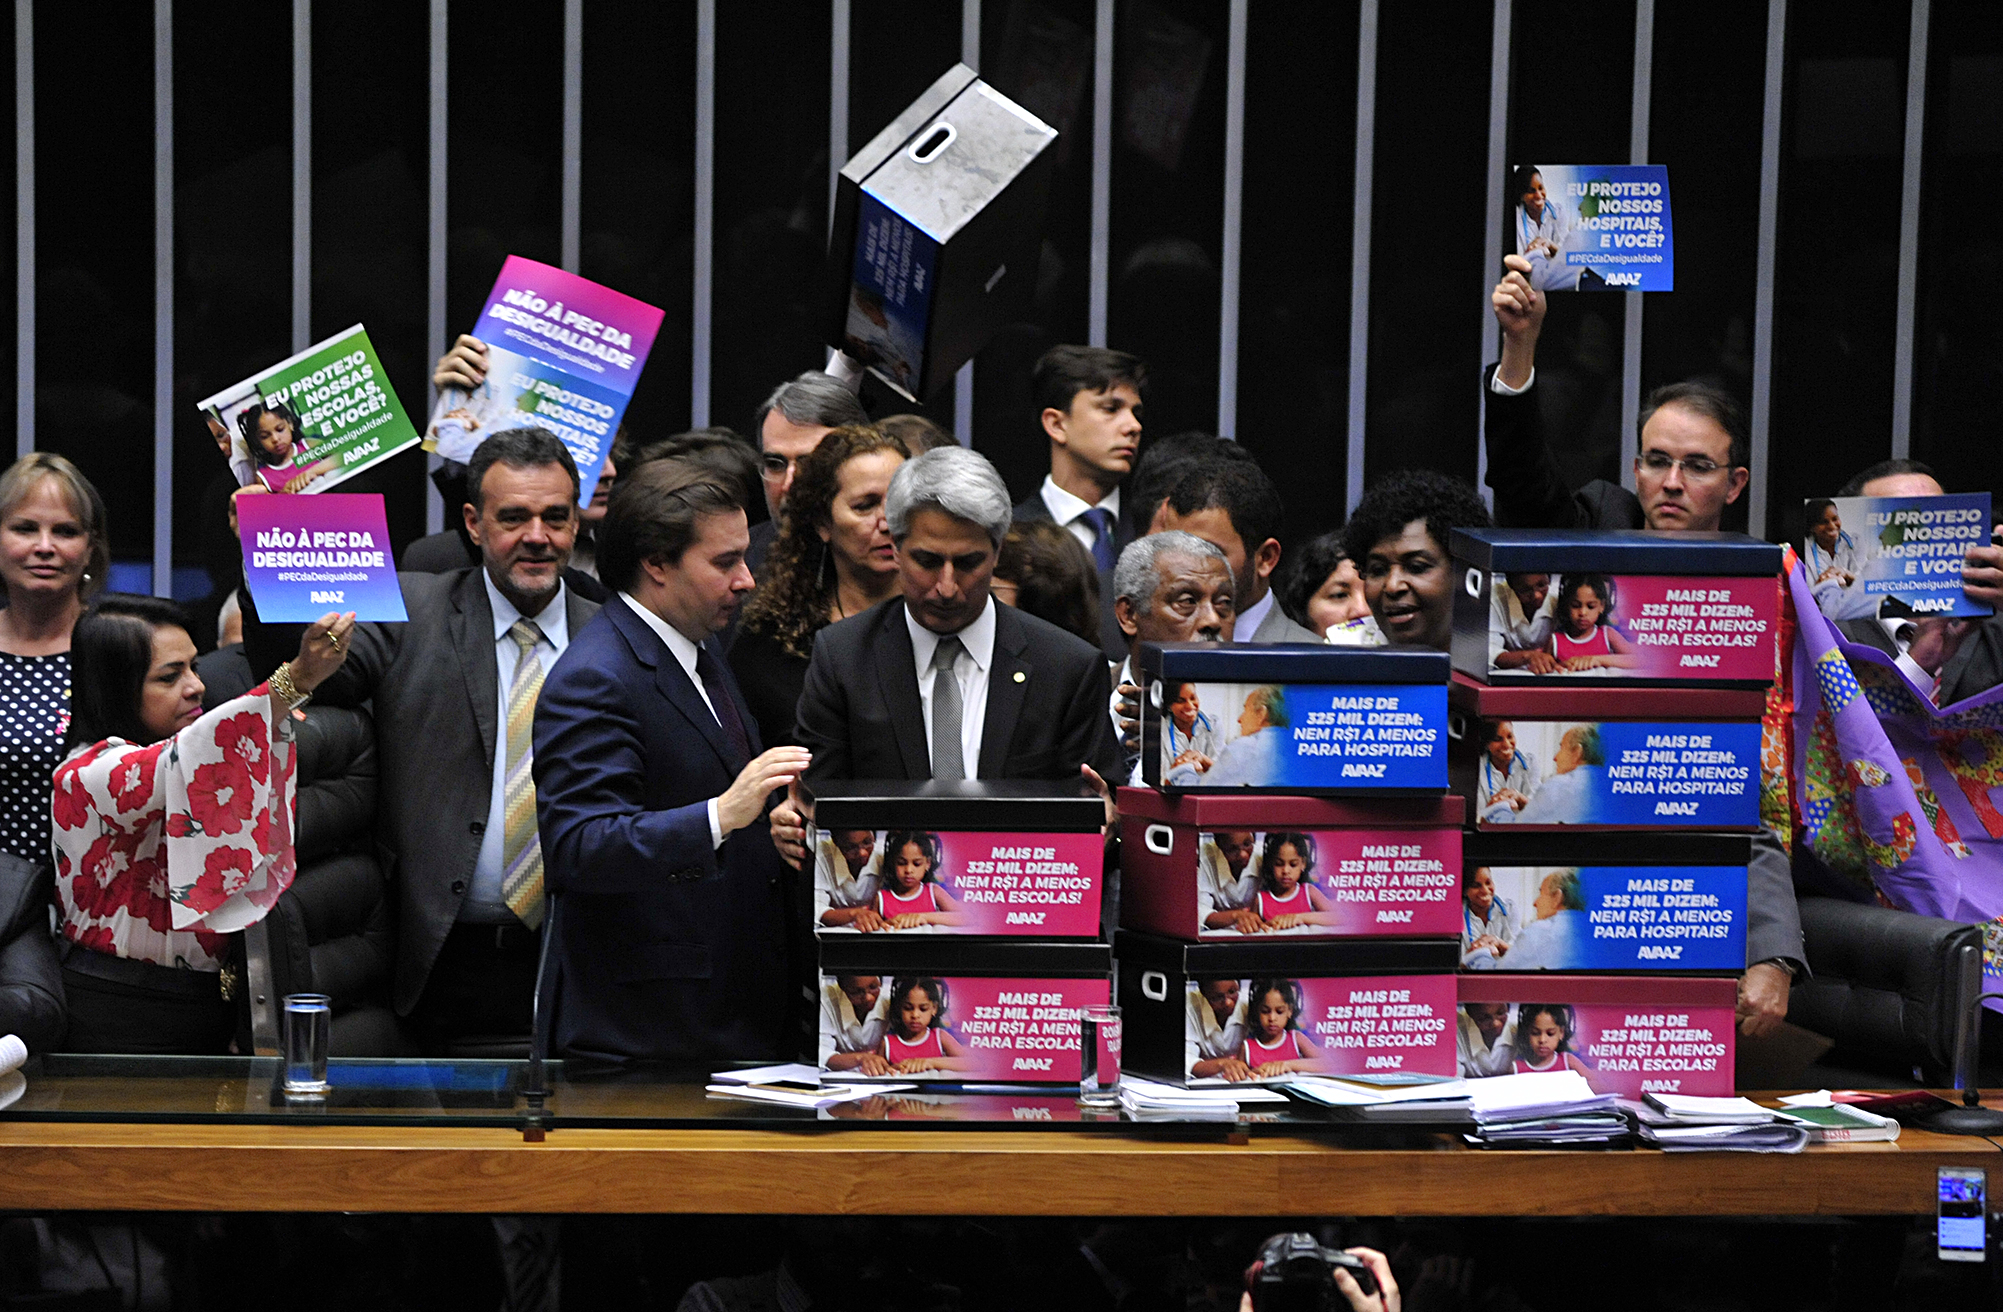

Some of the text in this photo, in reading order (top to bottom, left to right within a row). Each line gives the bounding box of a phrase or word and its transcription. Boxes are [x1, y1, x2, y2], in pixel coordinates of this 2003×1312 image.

[1567, 182, 1661, 197] EU PROTEJO
[1598, 199, 1663, 213] NOSSOS
[1576, 217, 1663, 232] HOSPITAIS,
[1600, 231, 1665, 248] E VOCÊ?
[1568, 253, 1663, 265] #PECdaDesigualdade
[1605, 272, 1642, 286] AVAAZ
[502, 288, 548, 313] NÃO
[561, 309, 605, 337] PEC
[600, 326, 632, 350] DA
[488, 303, 637, 370] DESIGUALDADE
[265, 350, 366, 410] EU PROTEJO
[305, 364, 374, 408] NOSSAS
[300, 380, 381, 428] ESCOLAS,
[533, 380, 616, 420] PROTEJO
[320, 393, 387, 437] E VOCÊ?
[535, 399, 611, 436] NOSSOS
[296, 412, 393, 466] #PECdaDesigualdade
[343, 437, 380, 465] AVAAZ
[1866, 508, 1982, 526] EU PROTEJO
[256, 527, 375, 548] NÃO À PEC DA
[1903, 525, 1982, 541] NOSSOS
[252, 551, 385, 568] DESIGUALDADE
[1904, 559, 1966, 575] E VOC
[277, 571, 369, 583] #PECdaDesigualdade
[310, 590, 345, 604] AVAAZ
[1666, 589, 1731, 602] MAIS DE
[1641, 603, 1754, 618] 325 MIL DIZEM:
[1912, 598, 1955, 613] AVAAZ
[1628, 617, 1767, 633] NEM R$1 A MENOS
[1637, 633, 1757, 647] PARA ESCOLAS!
[1679, 655, 1721, 667] AVAAZ
[1331, 696, 1399, 710] MAIS DE
[1306, 712, 1424, 726] 325 MIL DIZEM:
[1293, 726, 1437, 743] NEM R$1 A MENOS
[1646, 735, 1712, 749] MAIS DE
[1297, 743, 1433, 757] PARA HOSPITAIS!
[1621, 750, 1736, 764] 325 MIL DIZEM:
[1341, 764, 1387, 778] AVAAZ
[1608, 764, 1749, 781] NEM R$1 A MENOS
[1611, 781, 1745, 795] PARA HOSPITAIS!
[1654, 801, 1699, 816] AVAAZ
[991, 846, 1056, 860] MAIS DE
[1362, 845, 1422, 858] MAIS DE
[967, 861, 1079, 875] 325 MIL DIZEM:
[1339, 860, 1443, 873] 325 MIL DIZEM:
[954, 874, 1092, 890] NEM R$1 A MENOS
[1328, 873, 1455, 889] NEM R$1 A MENOS
[1627, 879, 1695, 892] MAIS DE
[963, 890, 1082, 904] PARA ESCOLAS!
[1336, 889, 1447, 902] PARA ESCOLAS!
[1602, 894, 1719, 908] 325 MIL DIZEM:
[1005, 912, 1046, 925] AVAAZ
[1376, 910, 1414, 923] AVAAZ
[1589, 908, 1733, 925] NEM R$1 A MENOS
[1593, 925, 1729, 939] PARA HOSPITAIS!
[1637, 946, 1683, 960] AVAAZ
[998, 992, 1063, 1006] MAIS DE
[1349, 990, 1411, 1004] MAIS DE
[974, 1006, 1002, 1019] 325
[1003, 1007, 1030, 1020] MIL
[1326, 1004, 1433, 1019] 325 MIL DIZEM:
[961, 1021, 996, 1033] NEM
[999, 1020, 1025, 1036] R$1
[1027, 1022, 1039, 1034] A
[1315, 1018, 1446, 1035] NEM R$1 A MENOS
[1624, 1014, 1689, 1028] MAIS DE
[970, 1036, 1012, 1049] PARA
[1324, 1034, 1437, 1049] PARA ESCOLAS!
[1600, 1029, 1712, 1042] 325 MIL DIZEM:
[1588, 1042, 1726, 1058] NEM R$1 A MENOS
[1012, 1058, 1053, 1070] AVAAZ
[1365, 1056, 1404, 1068] AVAAZ
[1598, 1058, 1717, 1071] PARA ESCOLAS!
[1641, 1079, 1681, 1092] AVAAZ
